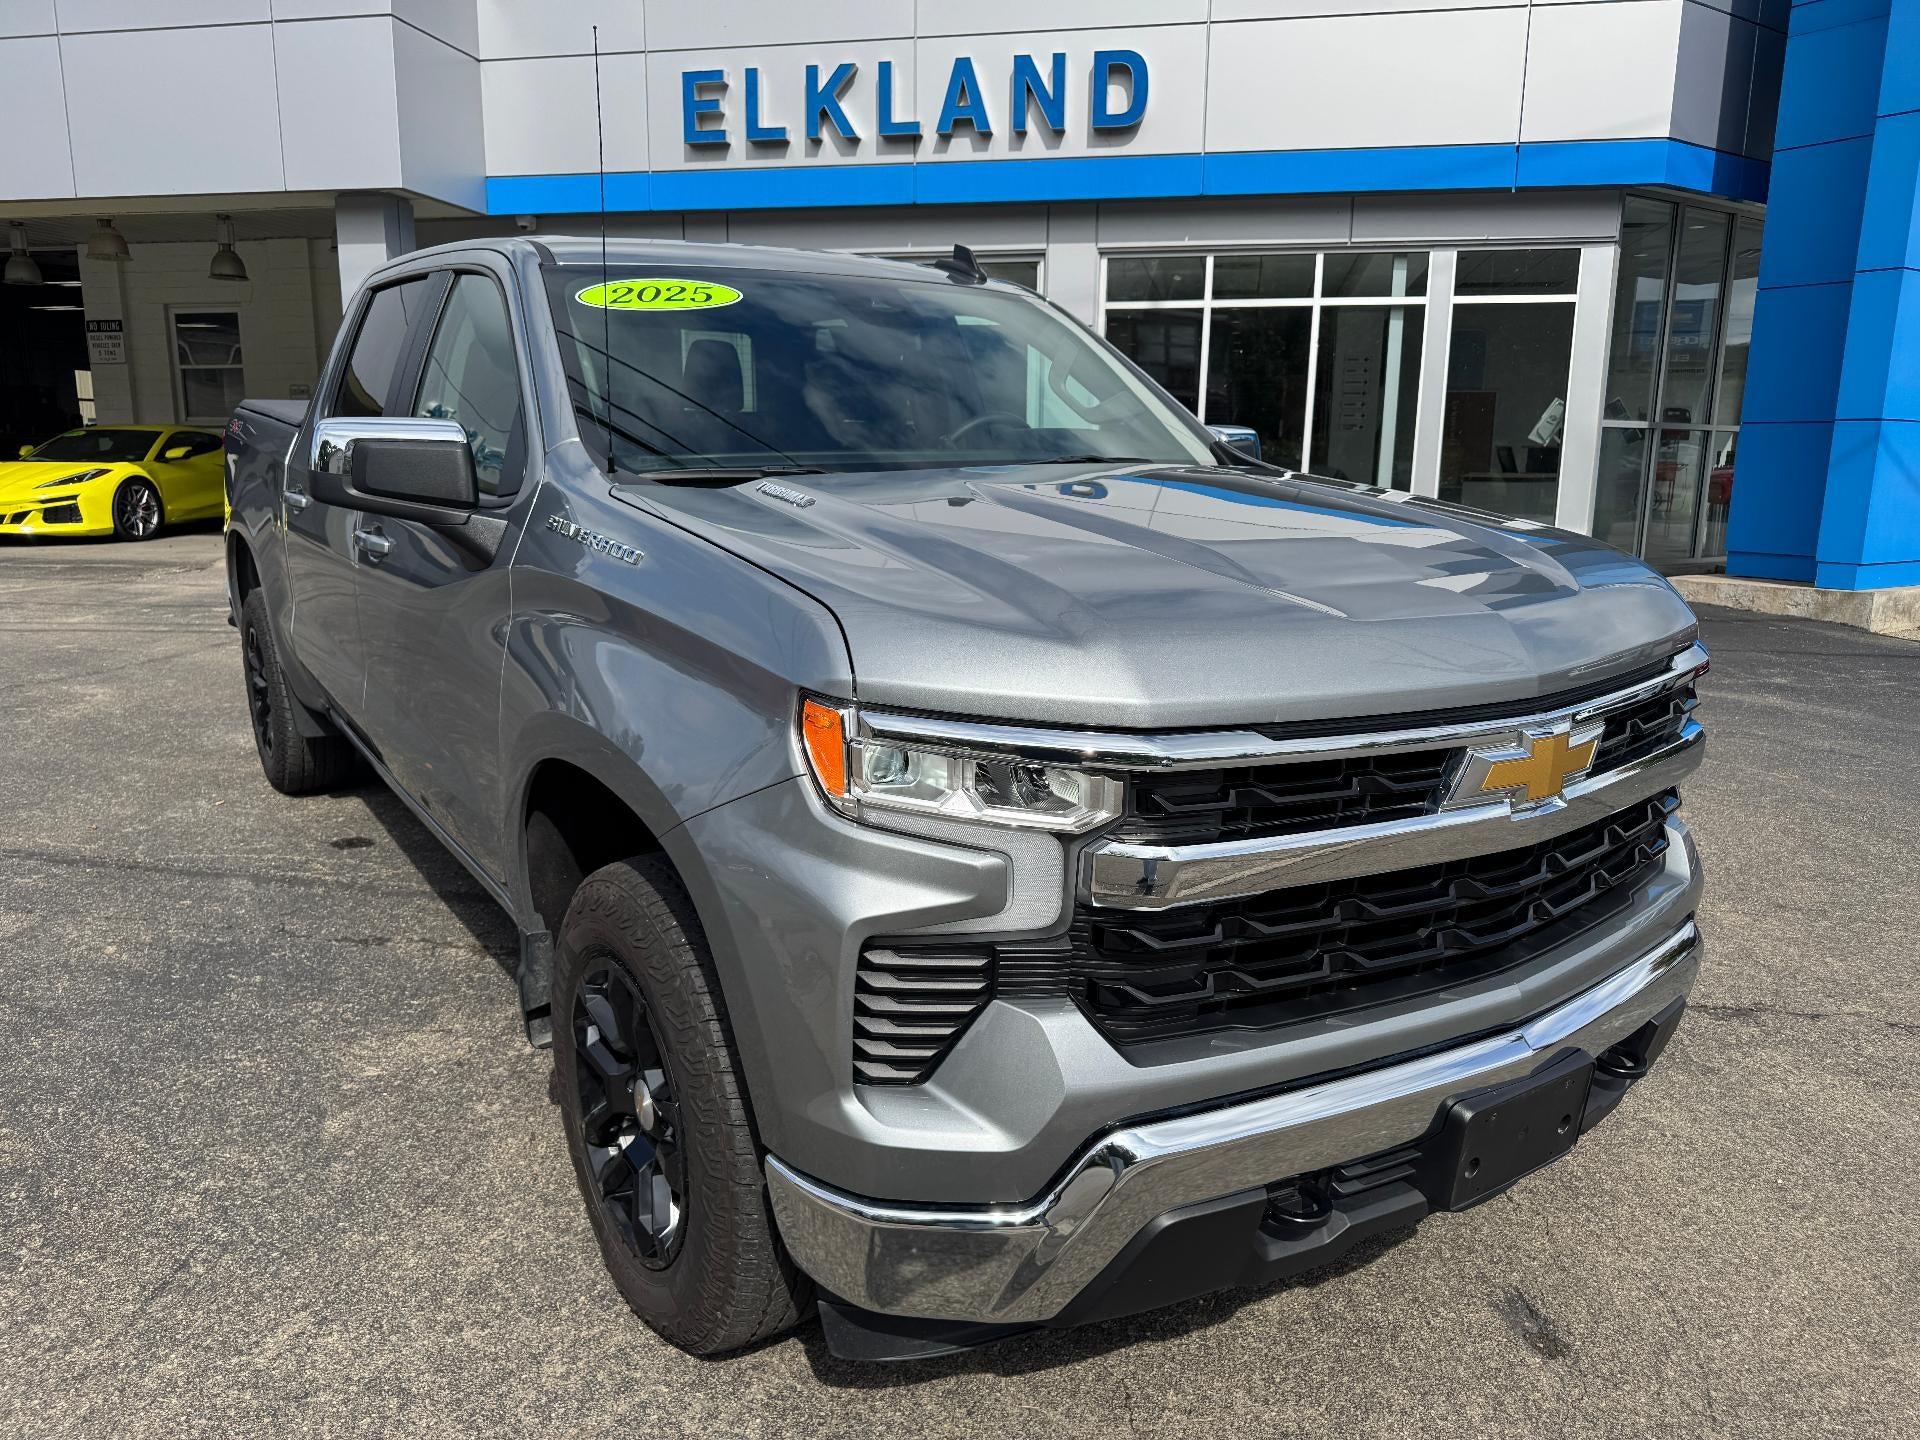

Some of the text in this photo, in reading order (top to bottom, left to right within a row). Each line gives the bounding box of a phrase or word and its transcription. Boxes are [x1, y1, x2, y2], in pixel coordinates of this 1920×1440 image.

[682, 49, 1149, 145] ELKLAND
[609, 285, 714, 304] 2025
[89, 321, 97, 331] NO
[545, 514, 645, 567] SILVERADO
